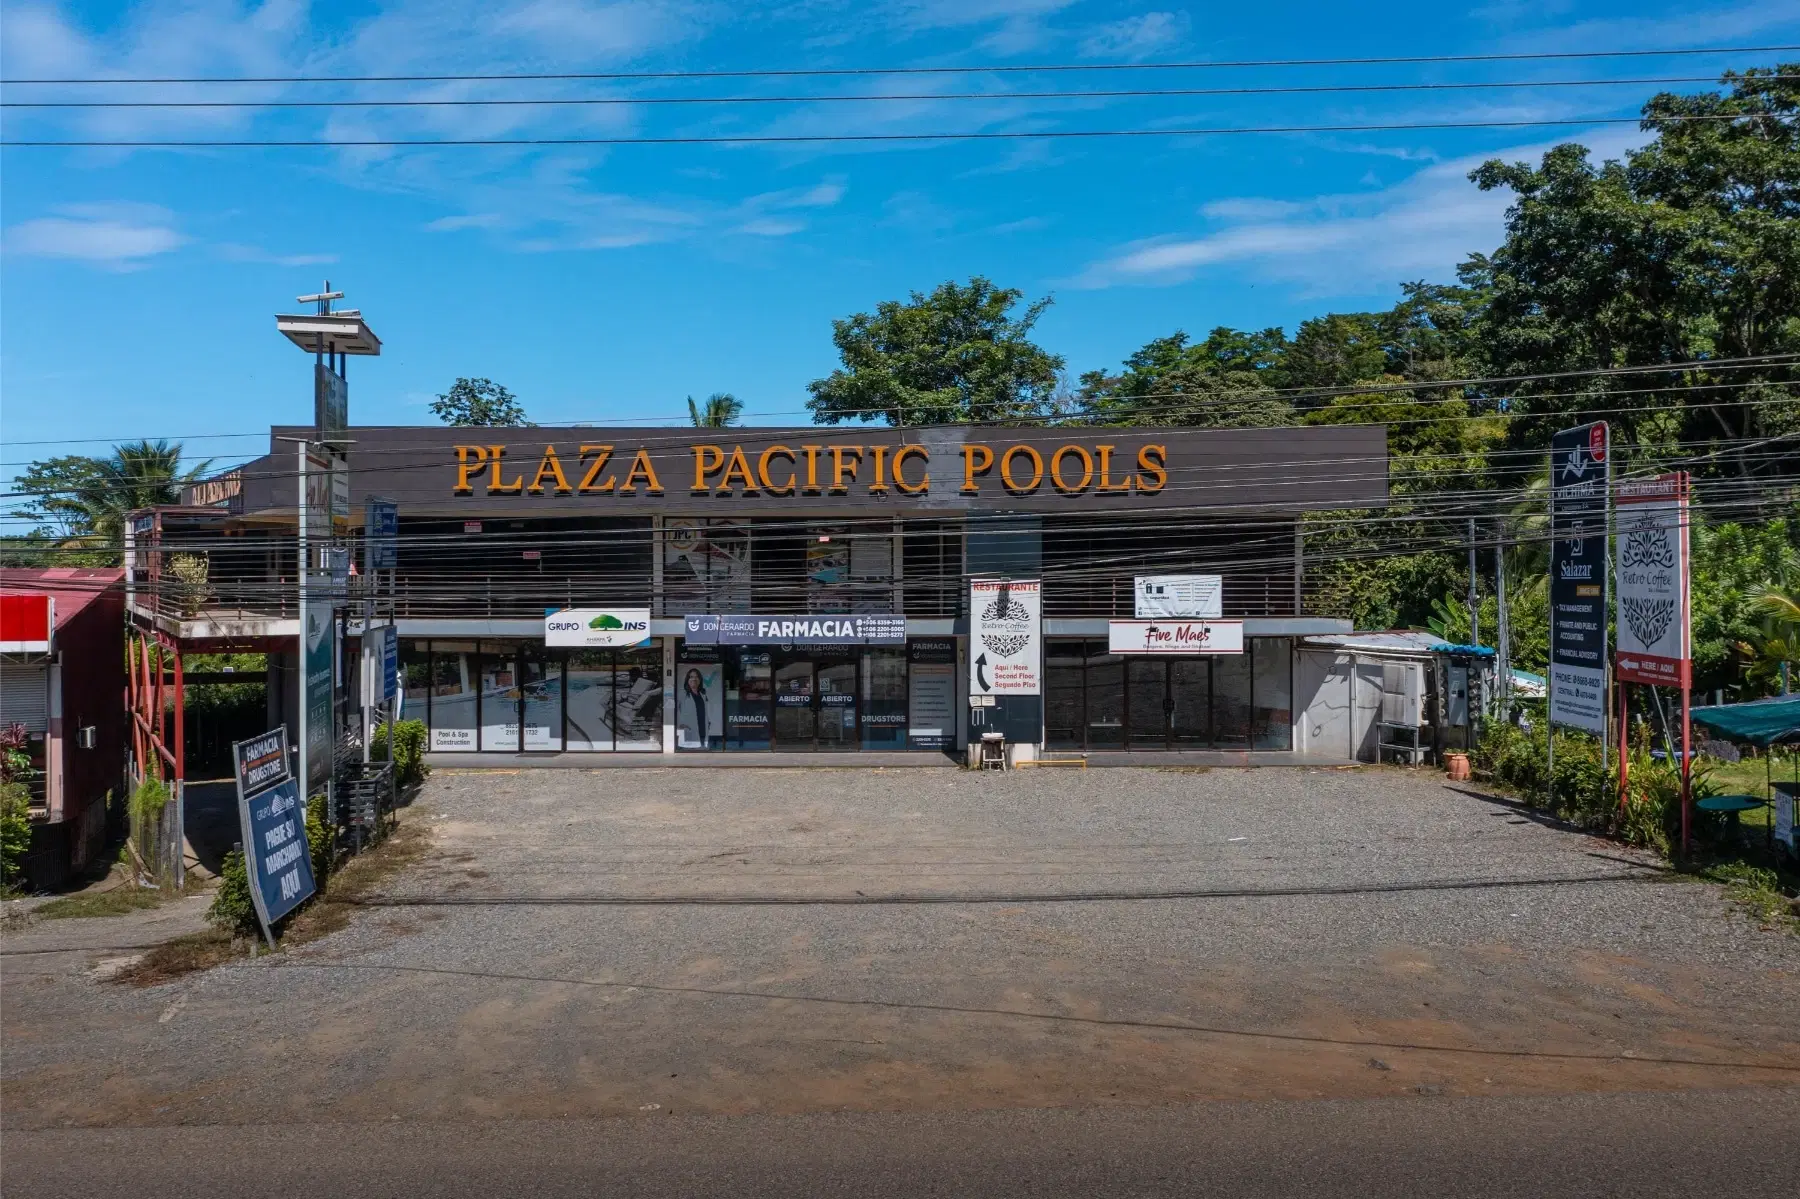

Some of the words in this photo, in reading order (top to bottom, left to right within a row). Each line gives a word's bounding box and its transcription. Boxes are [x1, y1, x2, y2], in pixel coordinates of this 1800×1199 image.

[453, 444, 665, 491] PLAZA
[690, 444, 930, 492] PACIFIC
[960, 444, 1168, 492] POOLS
[1561, 559, 1592, 577] Salazar
[973, 583, 1039, 591] RESTAURANTE
[1622, 571, 1645, 584] Retro
[1647, 570, 1672, 588] Coffee
[548, 622, 579, 631] GRUPO
[624, 622, 647, 631] INS
[758, 621, 855, 638] FARMACIA
[1145, 625, 1172, 643] Five
[1641, 660, 1656, 671] HERE
[994, 681, 1021, 689] Segundo
[728, 715, 768, 723] FARMACIA
[861, 715, 906, 723] DRUGSTORE
[246, 736, 279, 762] FARMACIA
[248, 759, 281, 785] DRUGSTORE
[256, 806, 271, 821] GRUPO
[265, 823, 287, 850] PAGUE
[285, 819, 295, 838] SU
[265, 839, 303, 876] MARCHAMO
[280, 862, 301, 901] AQUÍ
